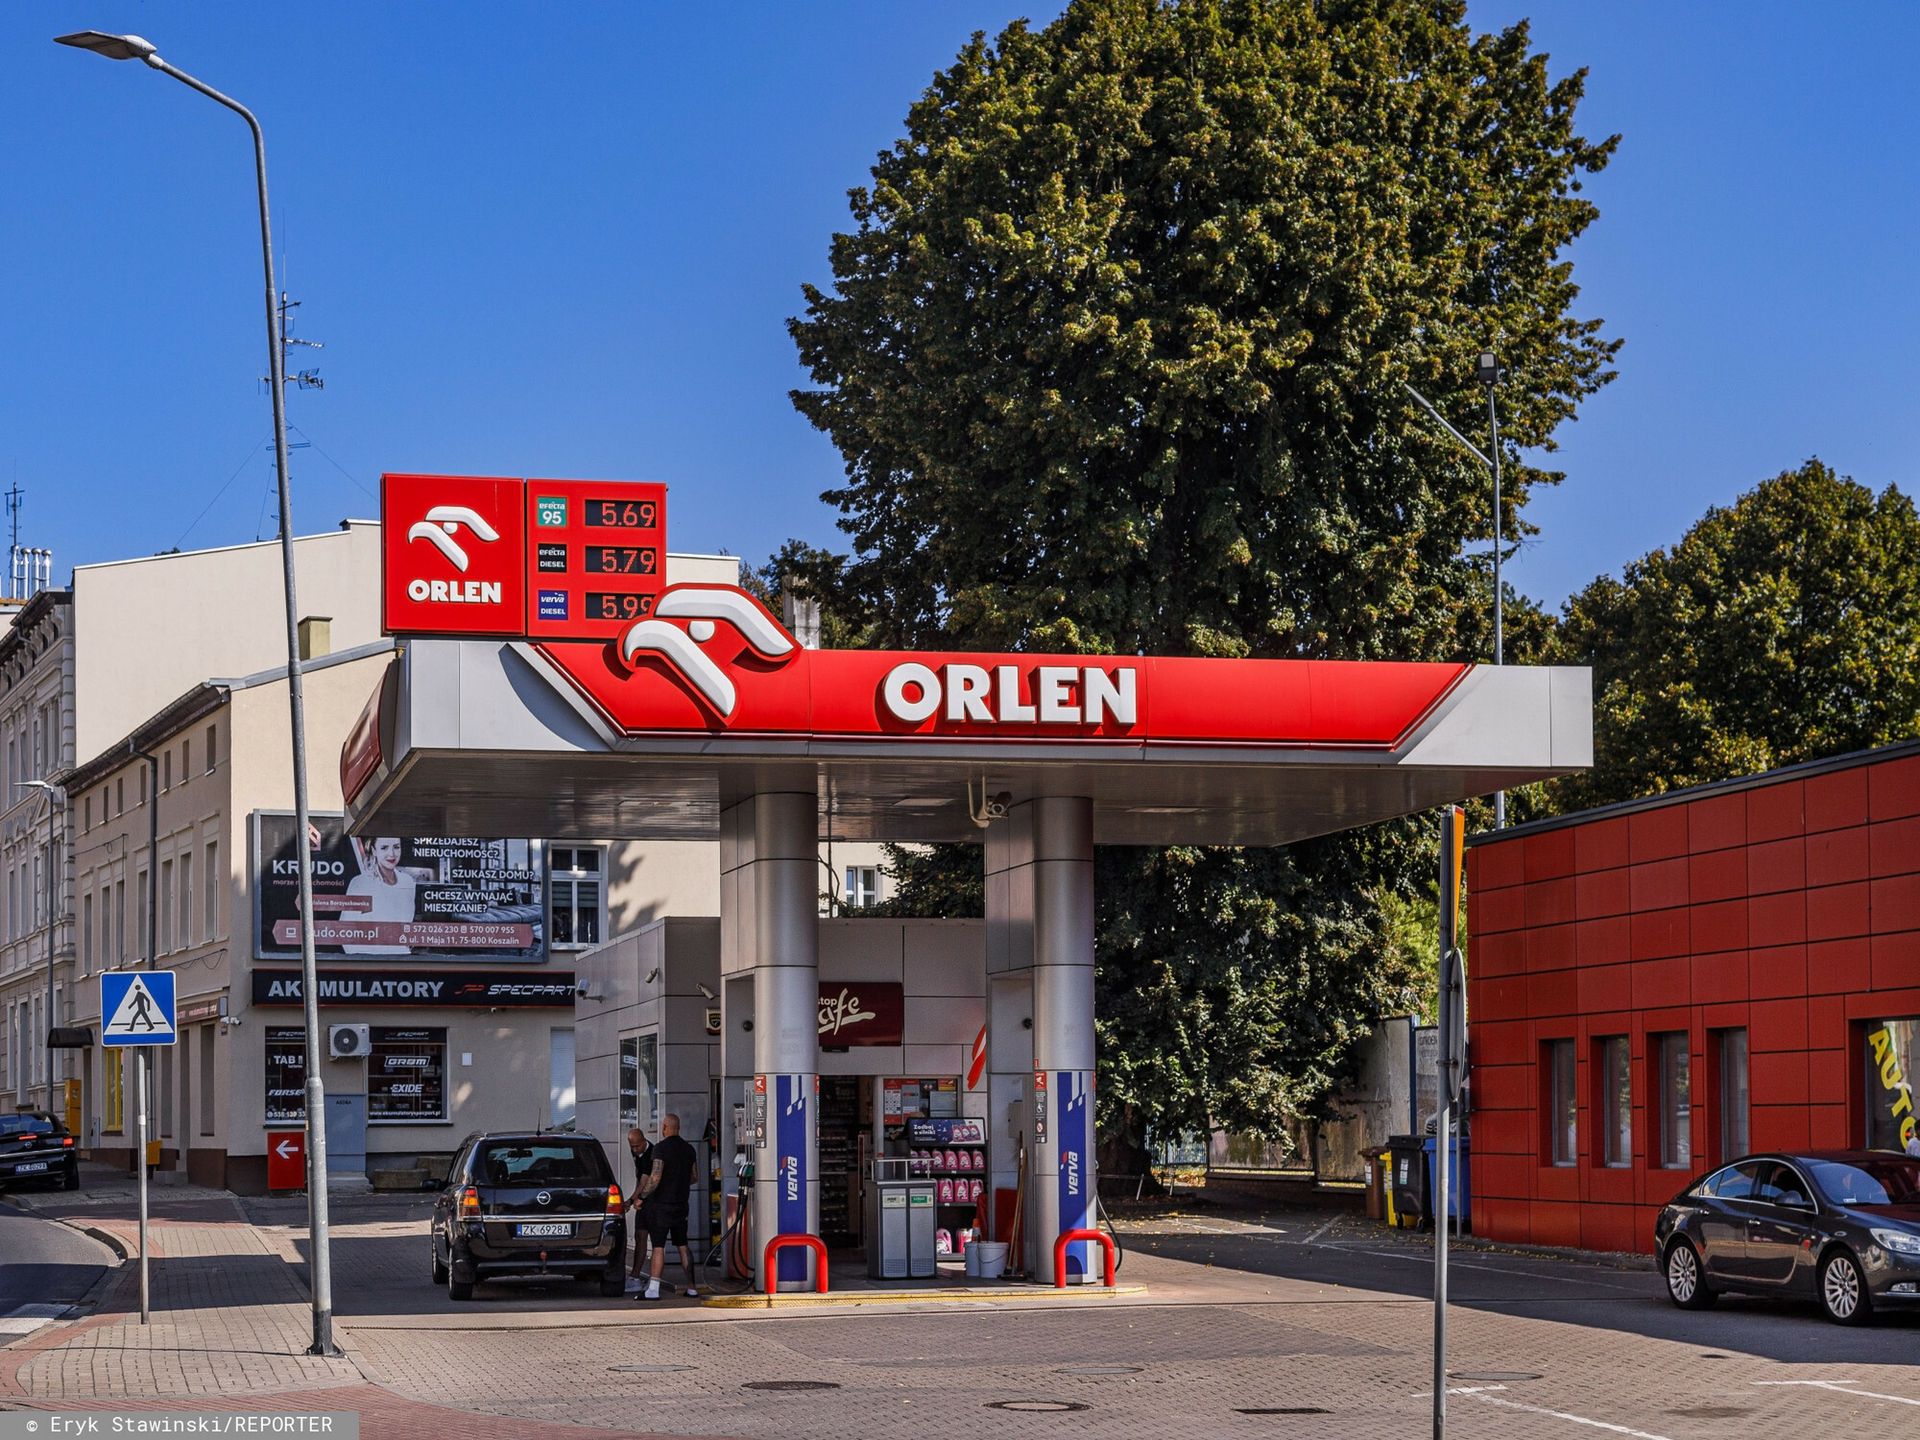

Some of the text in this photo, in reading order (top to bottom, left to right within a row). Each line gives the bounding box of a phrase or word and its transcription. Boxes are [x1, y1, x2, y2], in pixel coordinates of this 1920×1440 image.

[539, 501, 565, 509] efecta
[543, 511, 562, 524] 95
[602, 503, 655, 526] 5.69
[539, 548, 565, 556] efecta
[602, 549, 655, 573] 5.79
[408, 580, 502, 603] ORLEN
[884, 662, 1137, 724] ORLEN
[452, 869, 534, 880] SZUKASZ DOMU?
[424, 891, 514, 903] CHCESZ WYNAJĄĆ
[424, 903, 488, 912] MIESZKANIE?
[314, 927, 379, 940] udo.com.pl
[444, 925, 459, 933] 230
[427, 937, 445, 945] Maja
[488, 937, 520, 945] Koszalin
[268, 980, 444, 998] AKMULATORY
[818, 997, 837, 1007] top
[274, 1055, 296, 1064] TAB
[390, 1084, 424, 1093] EXIDE
[787, 1156, 798, 1201] verva
[1068, 1151, 1078, 1195] verva
[523, 1225, 536, 1235] ZK
